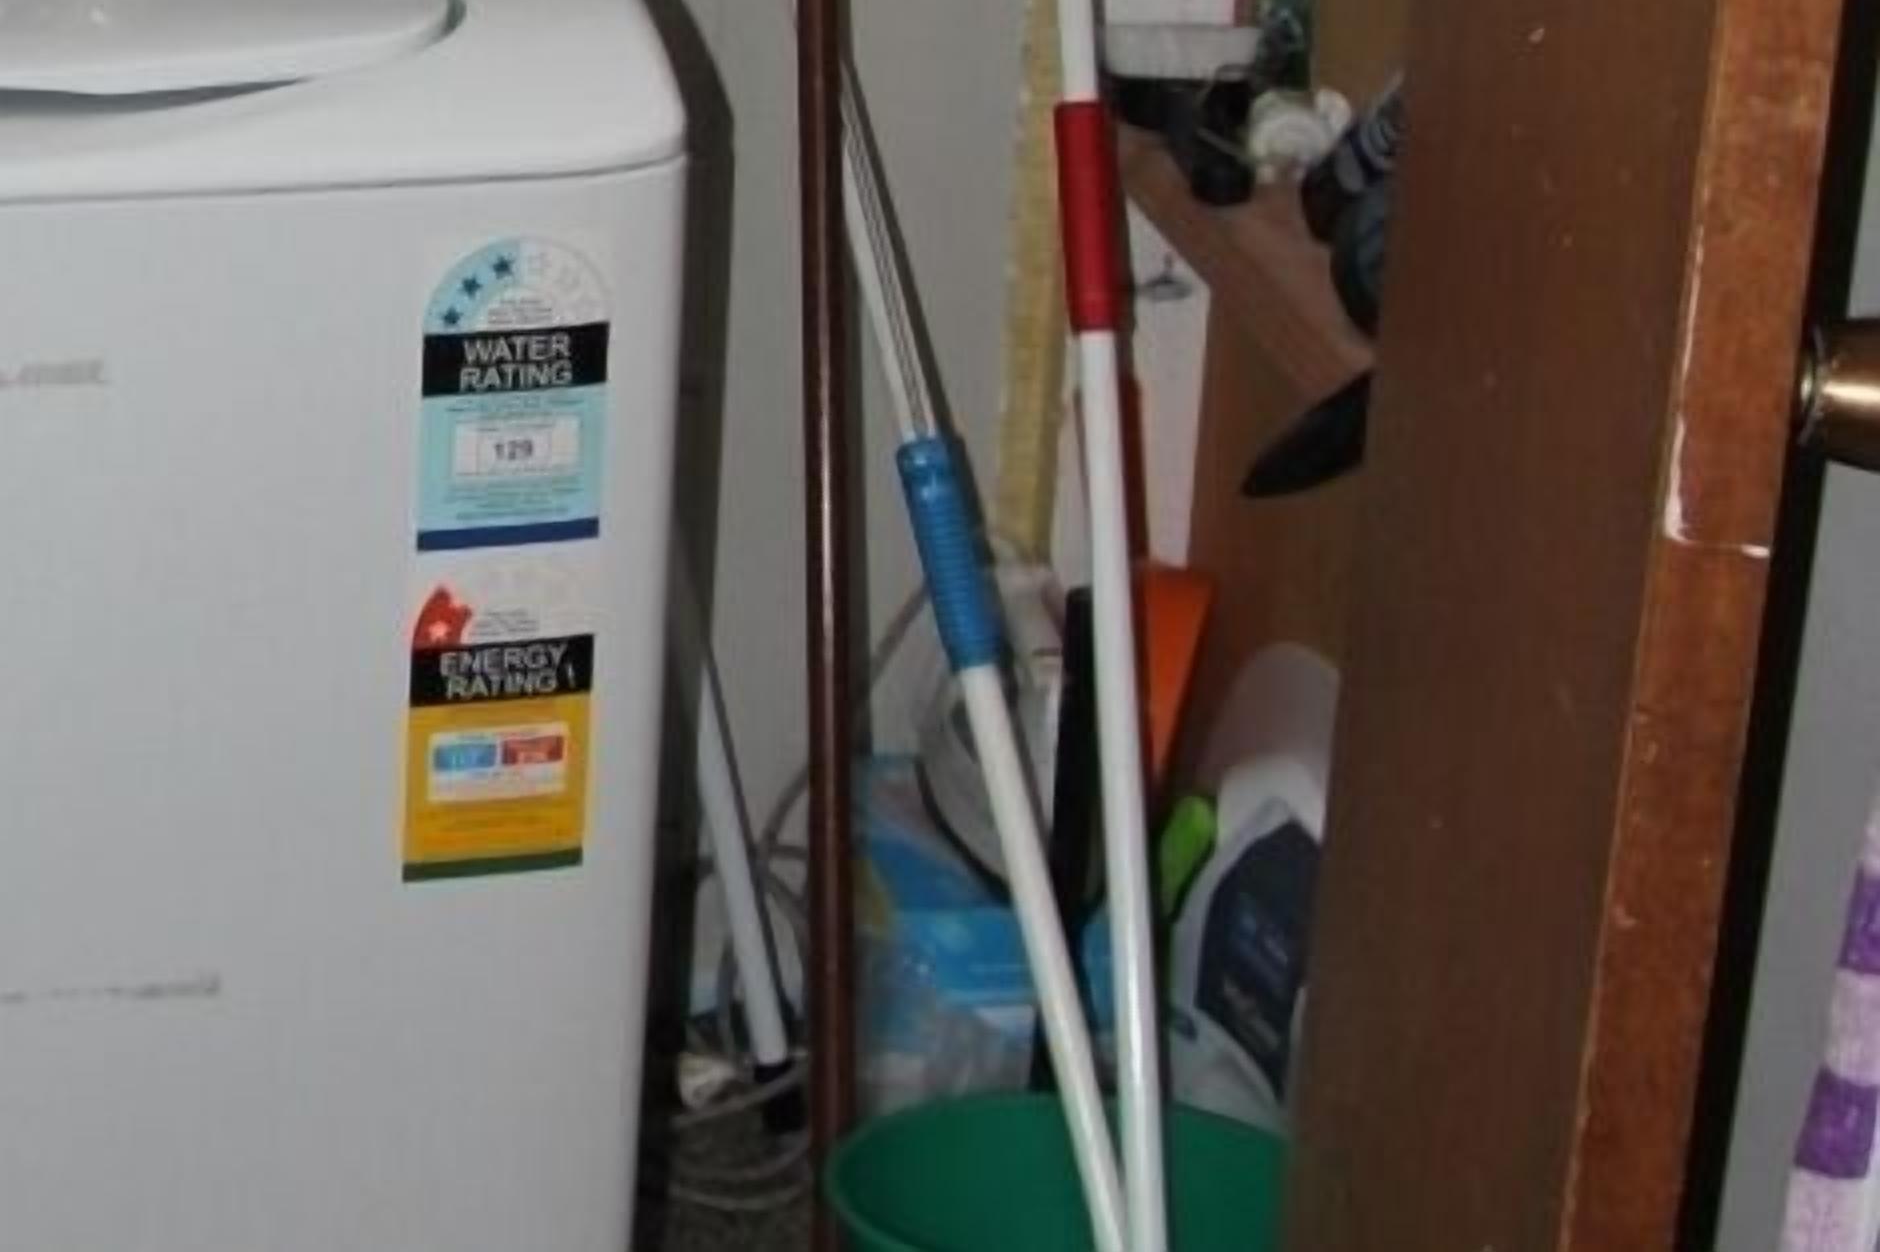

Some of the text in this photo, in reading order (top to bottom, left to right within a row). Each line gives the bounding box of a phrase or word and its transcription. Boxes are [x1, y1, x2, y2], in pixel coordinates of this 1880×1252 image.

[463, 332, 572, 364] WATER
[459, 359, 573, 393] RATING
[439, 642, 569, 677] ENERGY
[446, 668, 558, 700] RATING
